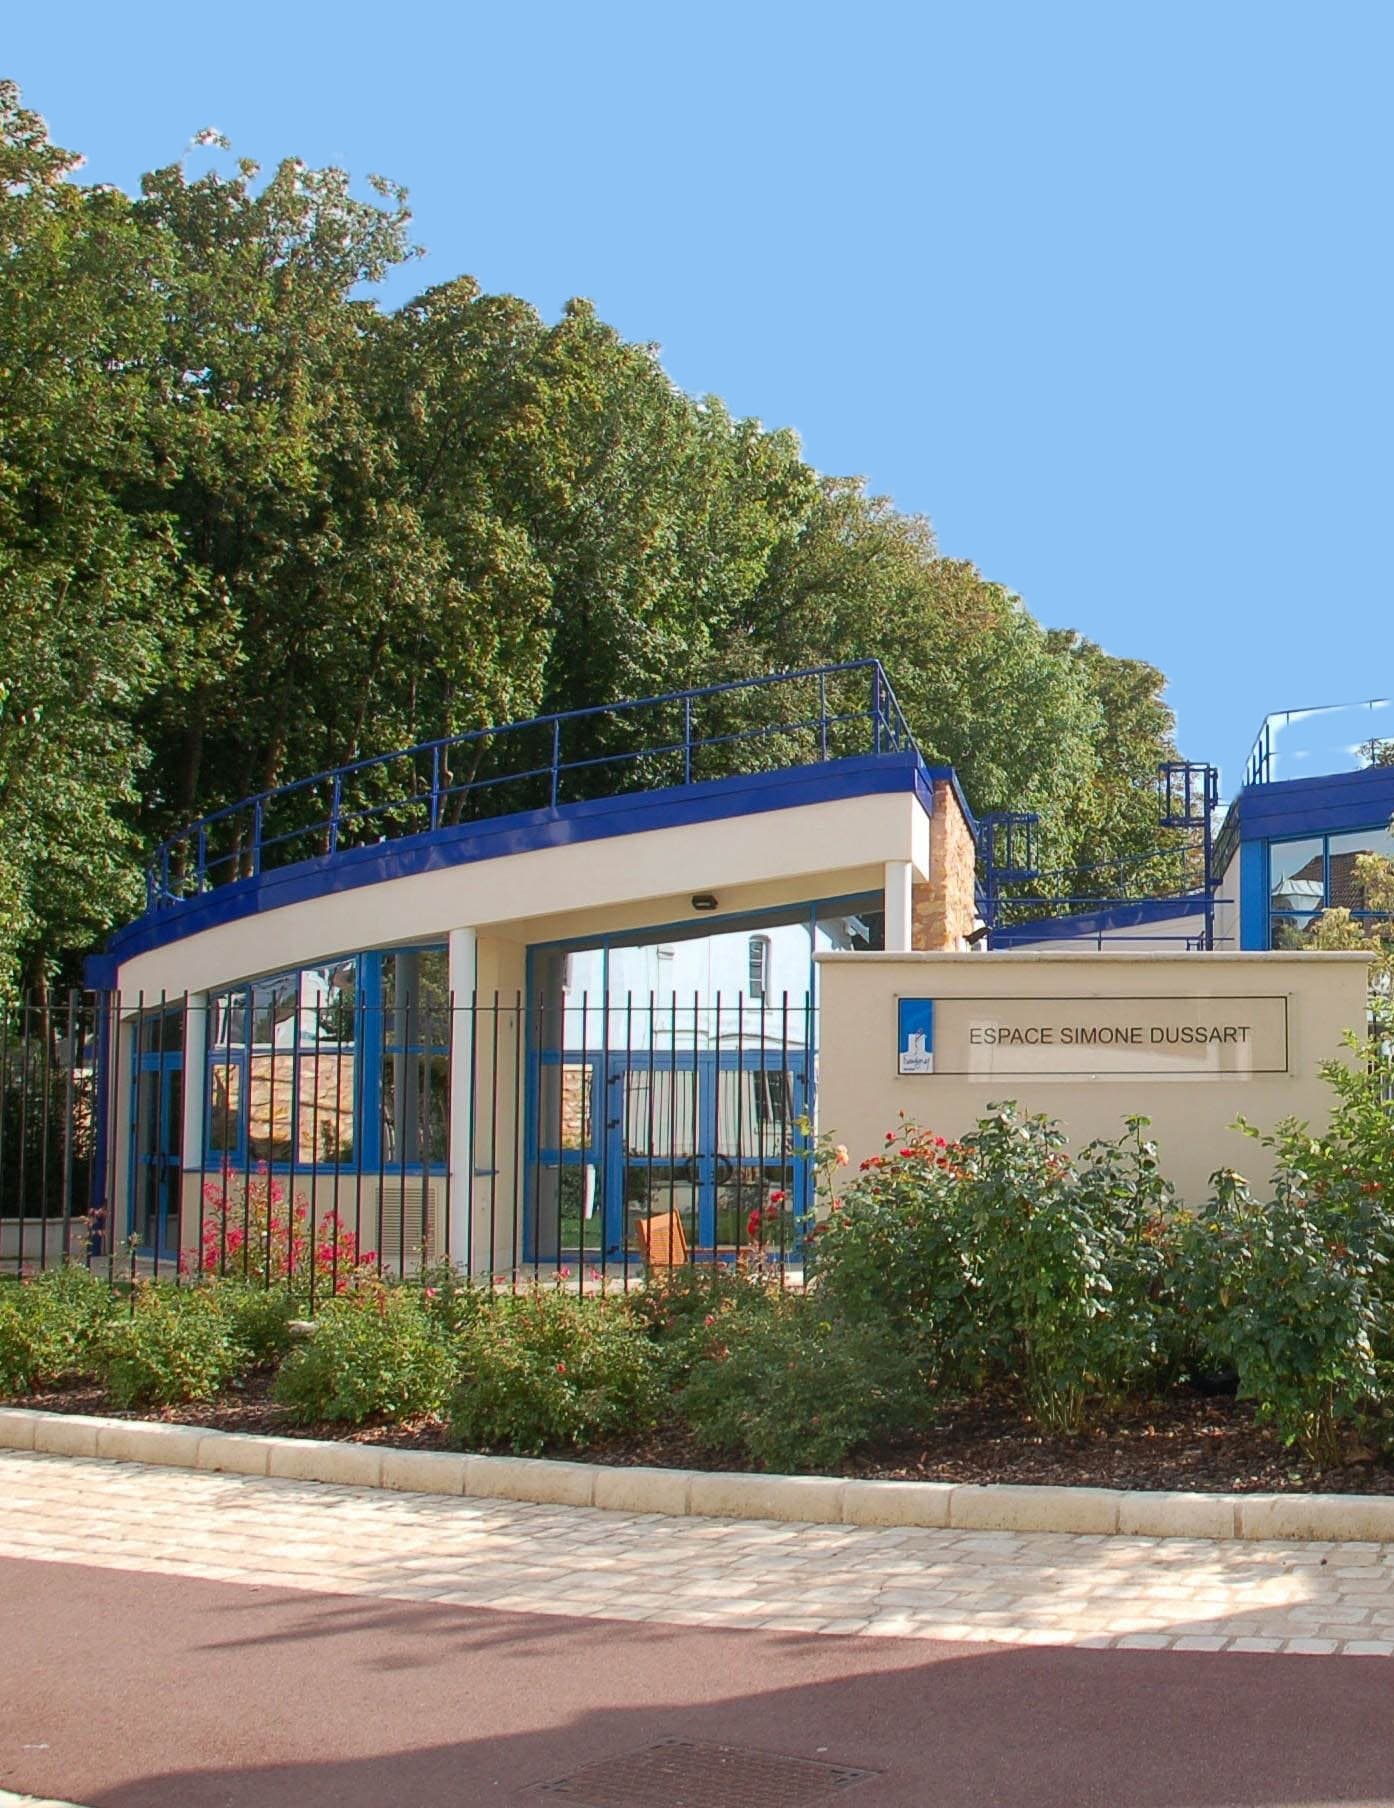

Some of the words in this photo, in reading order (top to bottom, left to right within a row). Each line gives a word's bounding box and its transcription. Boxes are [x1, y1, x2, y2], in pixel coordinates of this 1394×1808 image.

[969, 1027, 1054, 1045] ESPACE
[1060, 1026, 1143, 1045] SIMONE
[1150, 1026, 1251, 1044] DUSSART
